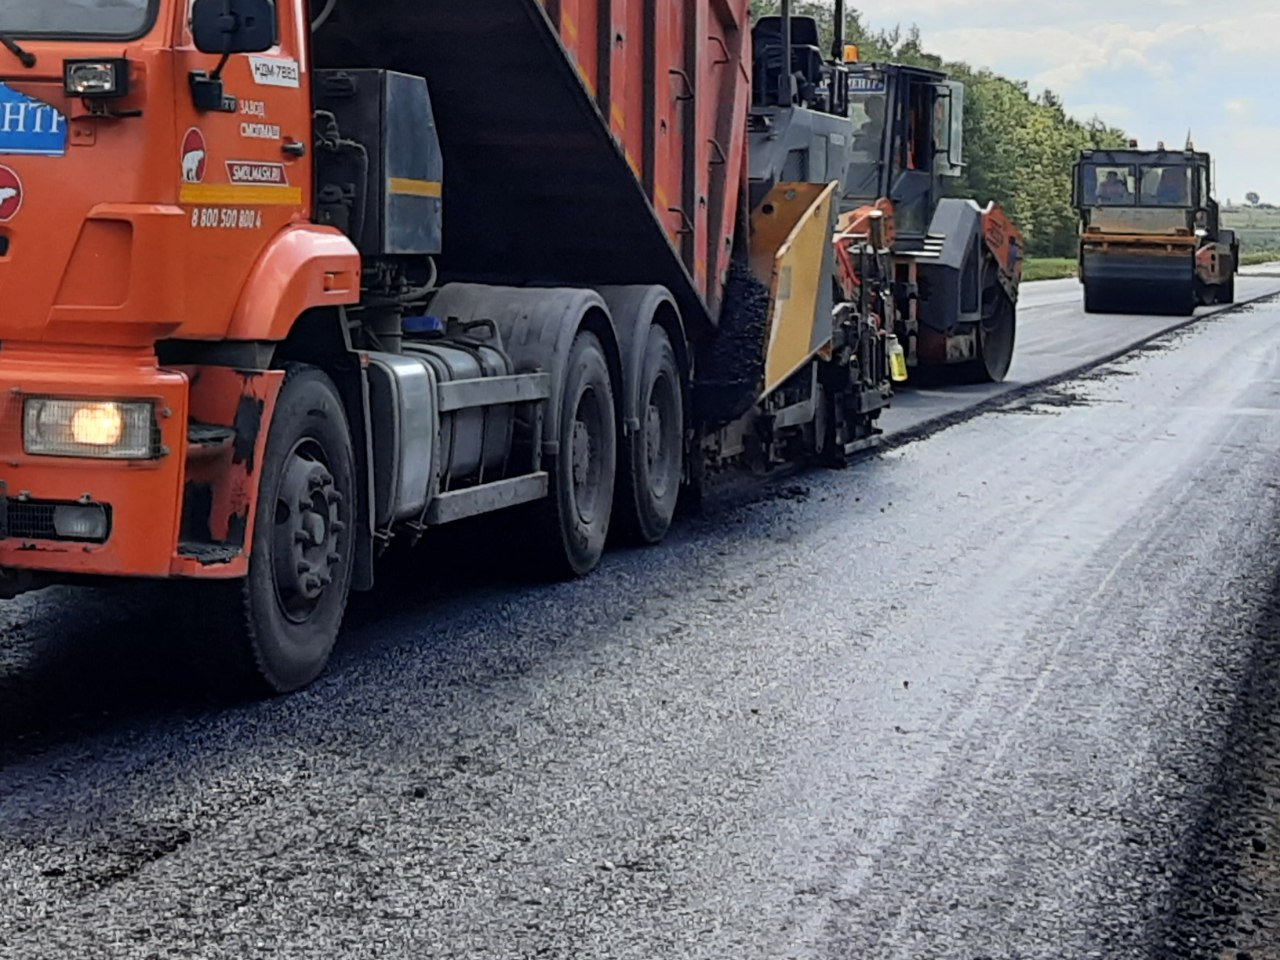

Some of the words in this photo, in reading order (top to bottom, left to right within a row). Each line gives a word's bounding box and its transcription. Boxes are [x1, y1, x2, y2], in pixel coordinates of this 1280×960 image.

[191, 208, 199, 227] 8
[200, 208, 219, 227] 800
[220, 208, 237, 227] 500
